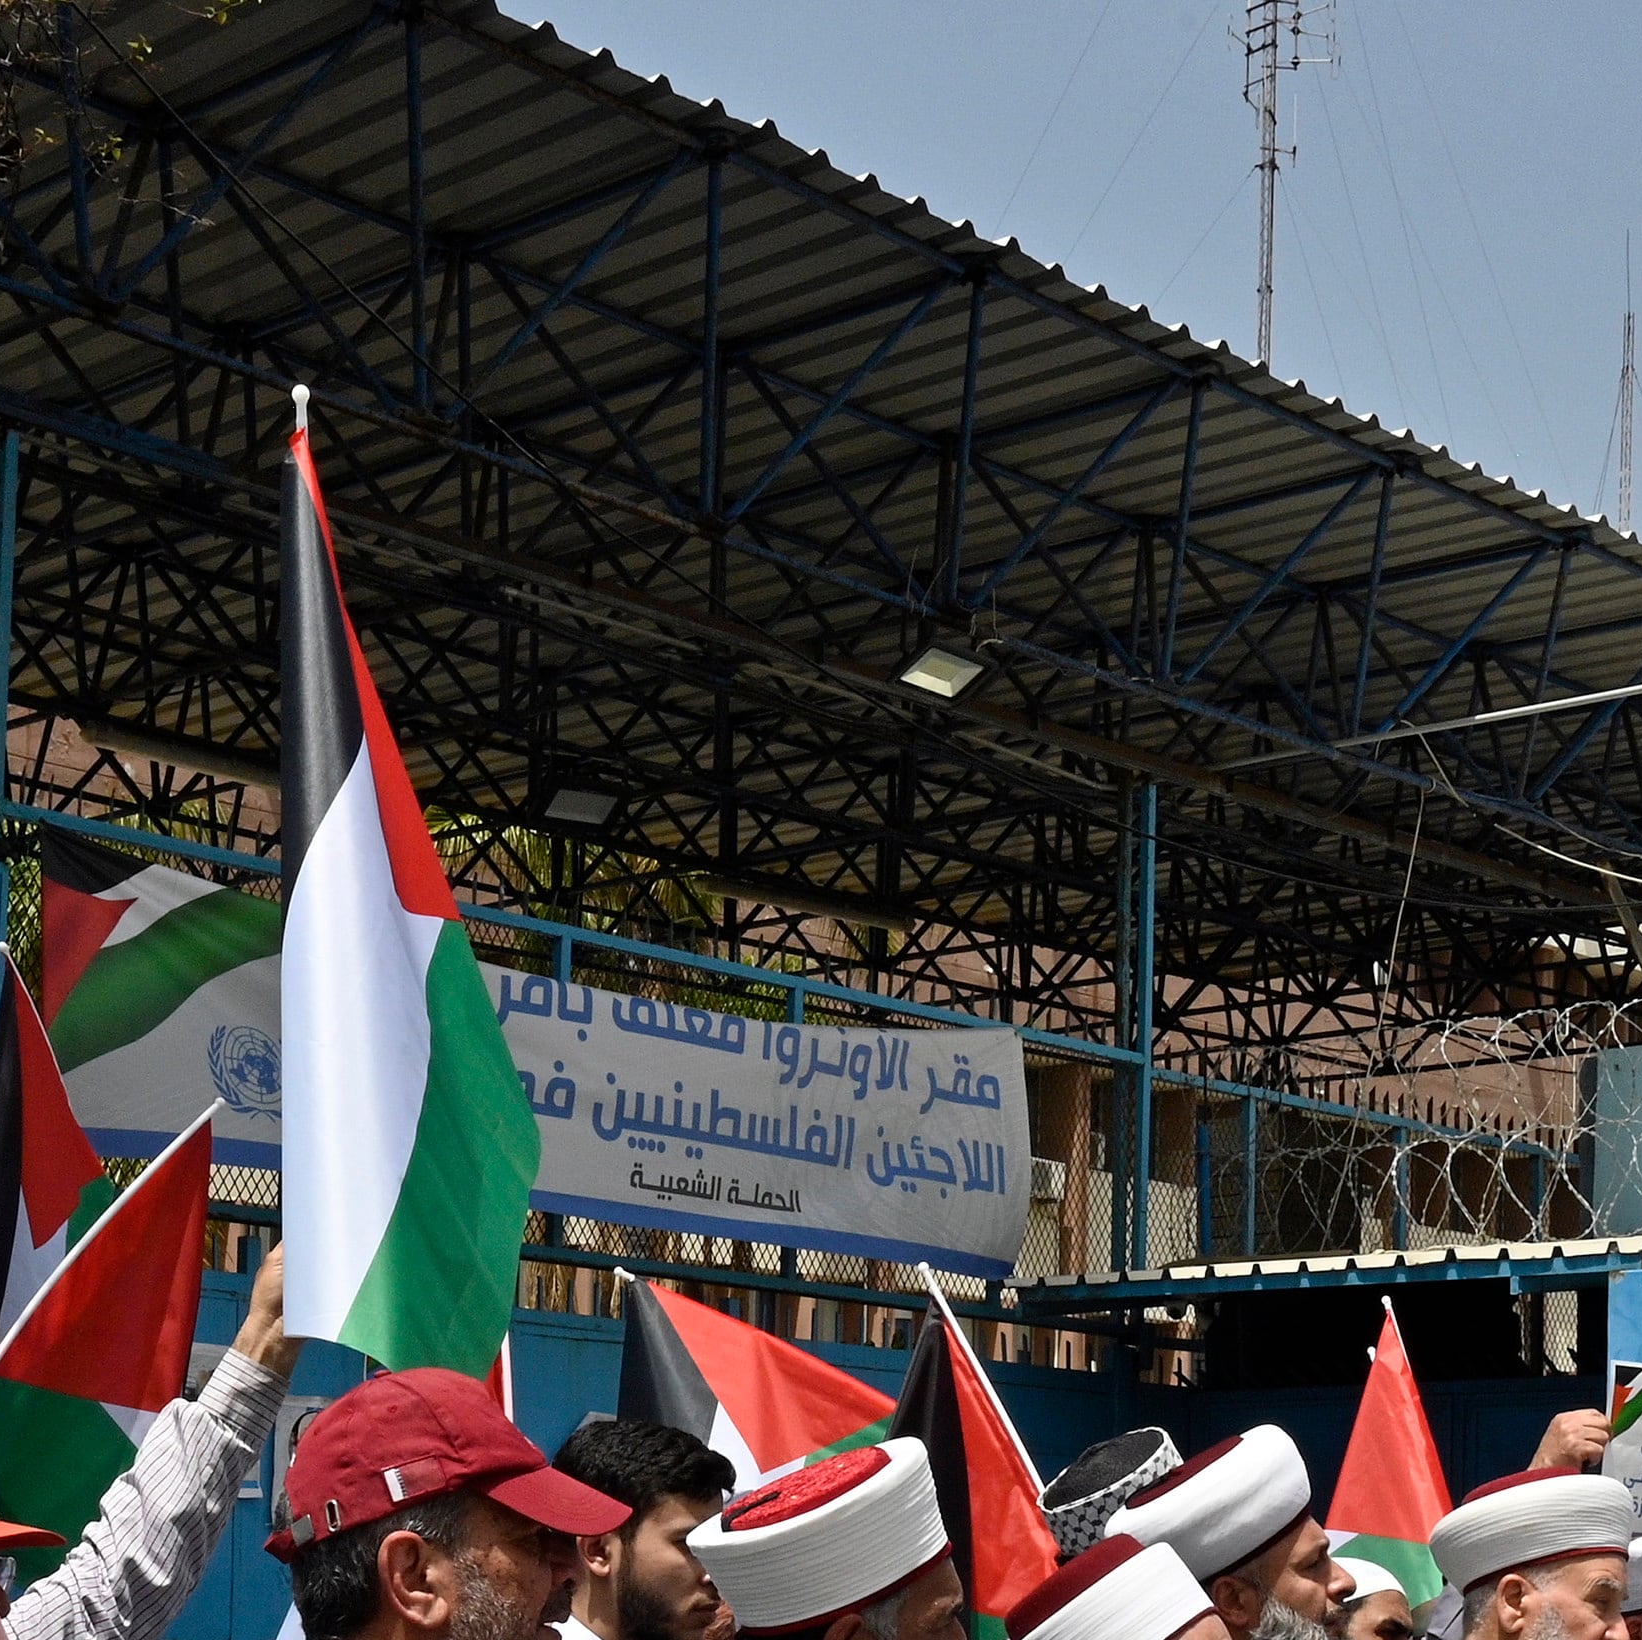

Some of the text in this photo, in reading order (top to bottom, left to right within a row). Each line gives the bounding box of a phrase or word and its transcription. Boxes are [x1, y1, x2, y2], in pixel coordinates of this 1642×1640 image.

[919, 1053, 1001, 1114] مقر
[592, 1072, 856, 1170] الفلسطينيين
[629, 1161, 802, 1214] الحملة الشعبية
[865, 1120, 1005, 1196] اللاجئين
